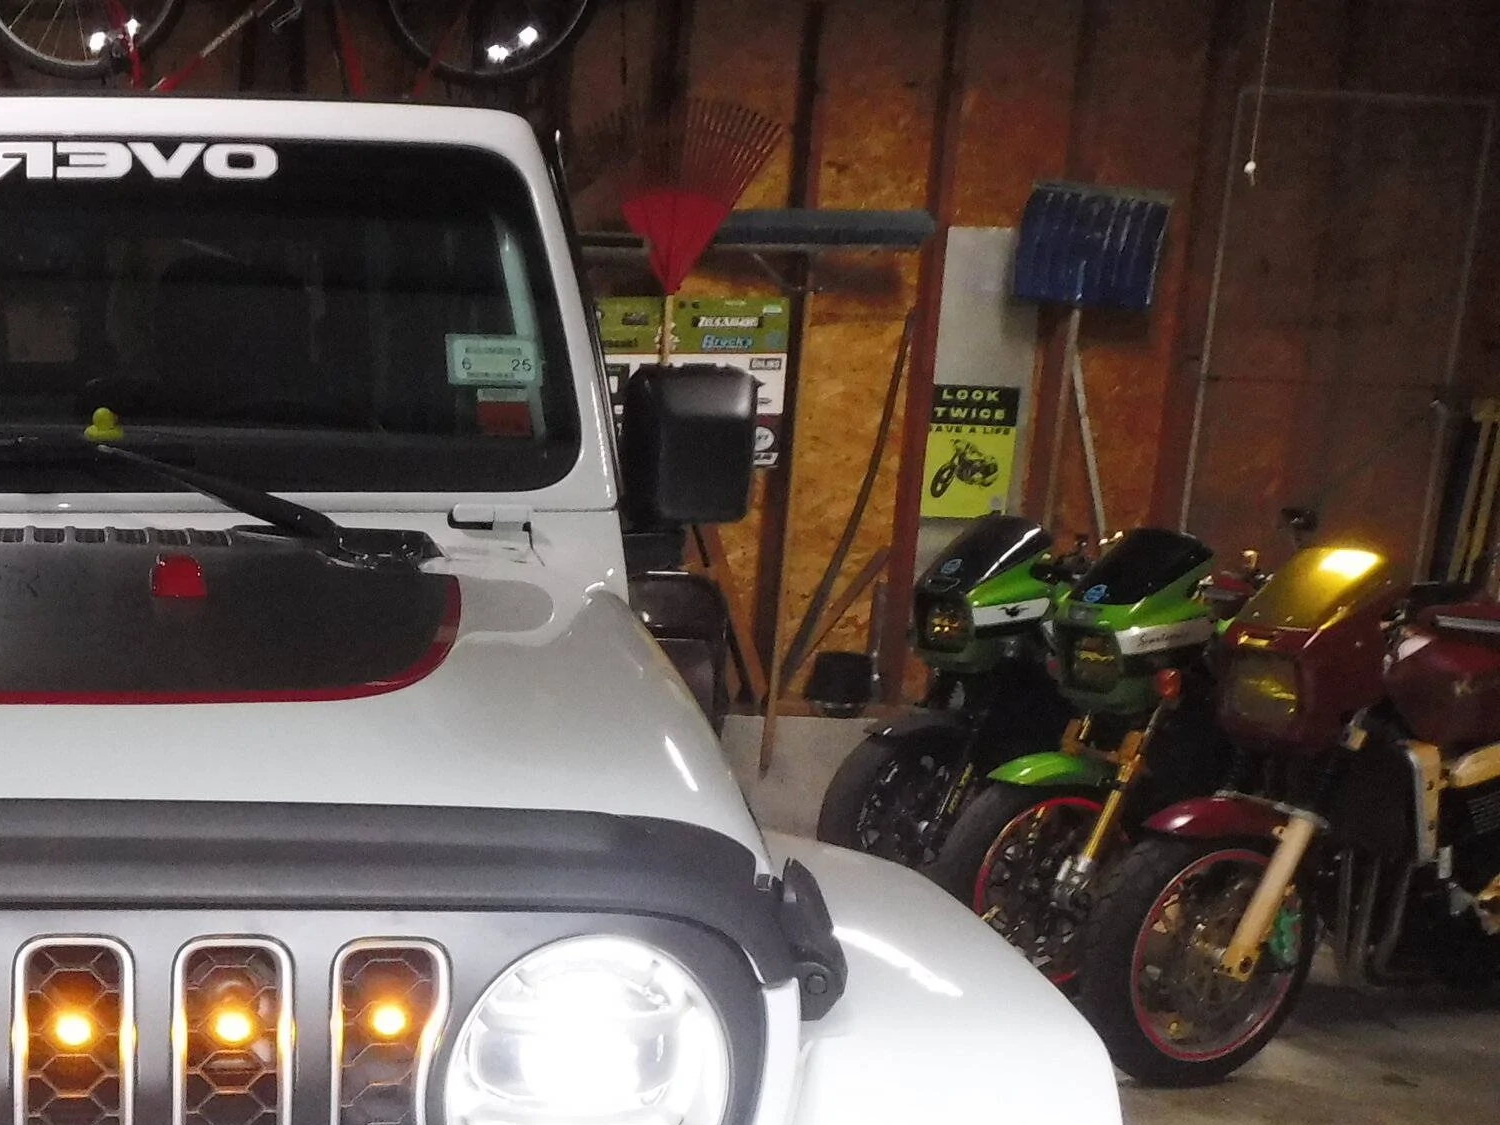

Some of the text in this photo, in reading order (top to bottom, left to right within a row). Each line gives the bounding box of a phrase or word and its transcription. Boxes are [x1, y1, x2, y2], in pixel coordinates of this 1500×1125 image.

[462, 357, 532, 372] 6 25
[942, 389, 1000, 401] LOOK
[934, 407, 1005, 420] TWICE
[968, 426, 977, 434] A
[983, 427, 1011, 436] LIFE
